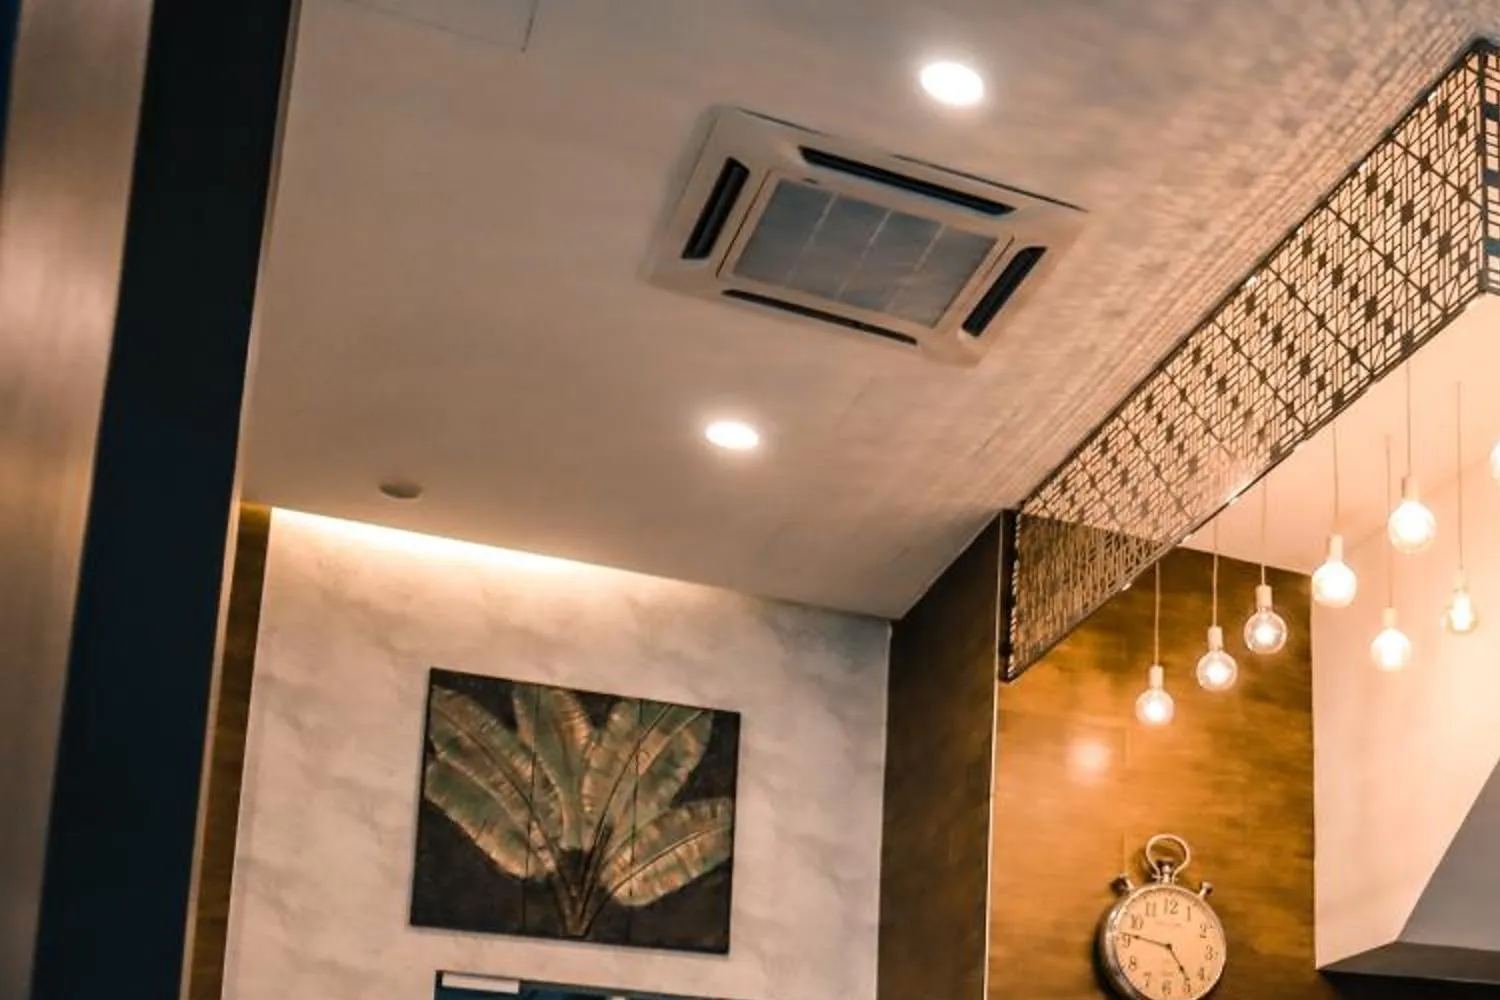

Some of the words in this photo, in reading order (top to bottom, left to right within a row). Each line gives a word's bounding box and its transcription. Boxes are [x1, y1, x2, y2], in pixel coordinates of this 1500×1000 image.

[1145, 901, 1156, 918] 11
[1163, 898, 1178, 915] 12
[1131, 914, 1144, 929] 10
[1199, 923, 1207, 939] 2
[1121, 932, 1131, 948] 9
[1204, 944, 1213, 961] 3
[1128, 955, 1137, 972] 8
[1143, 971, 1152, 988] 7
[1198, 967, 1205, 981] 4
[1161, 980, 1172, 996] 6
